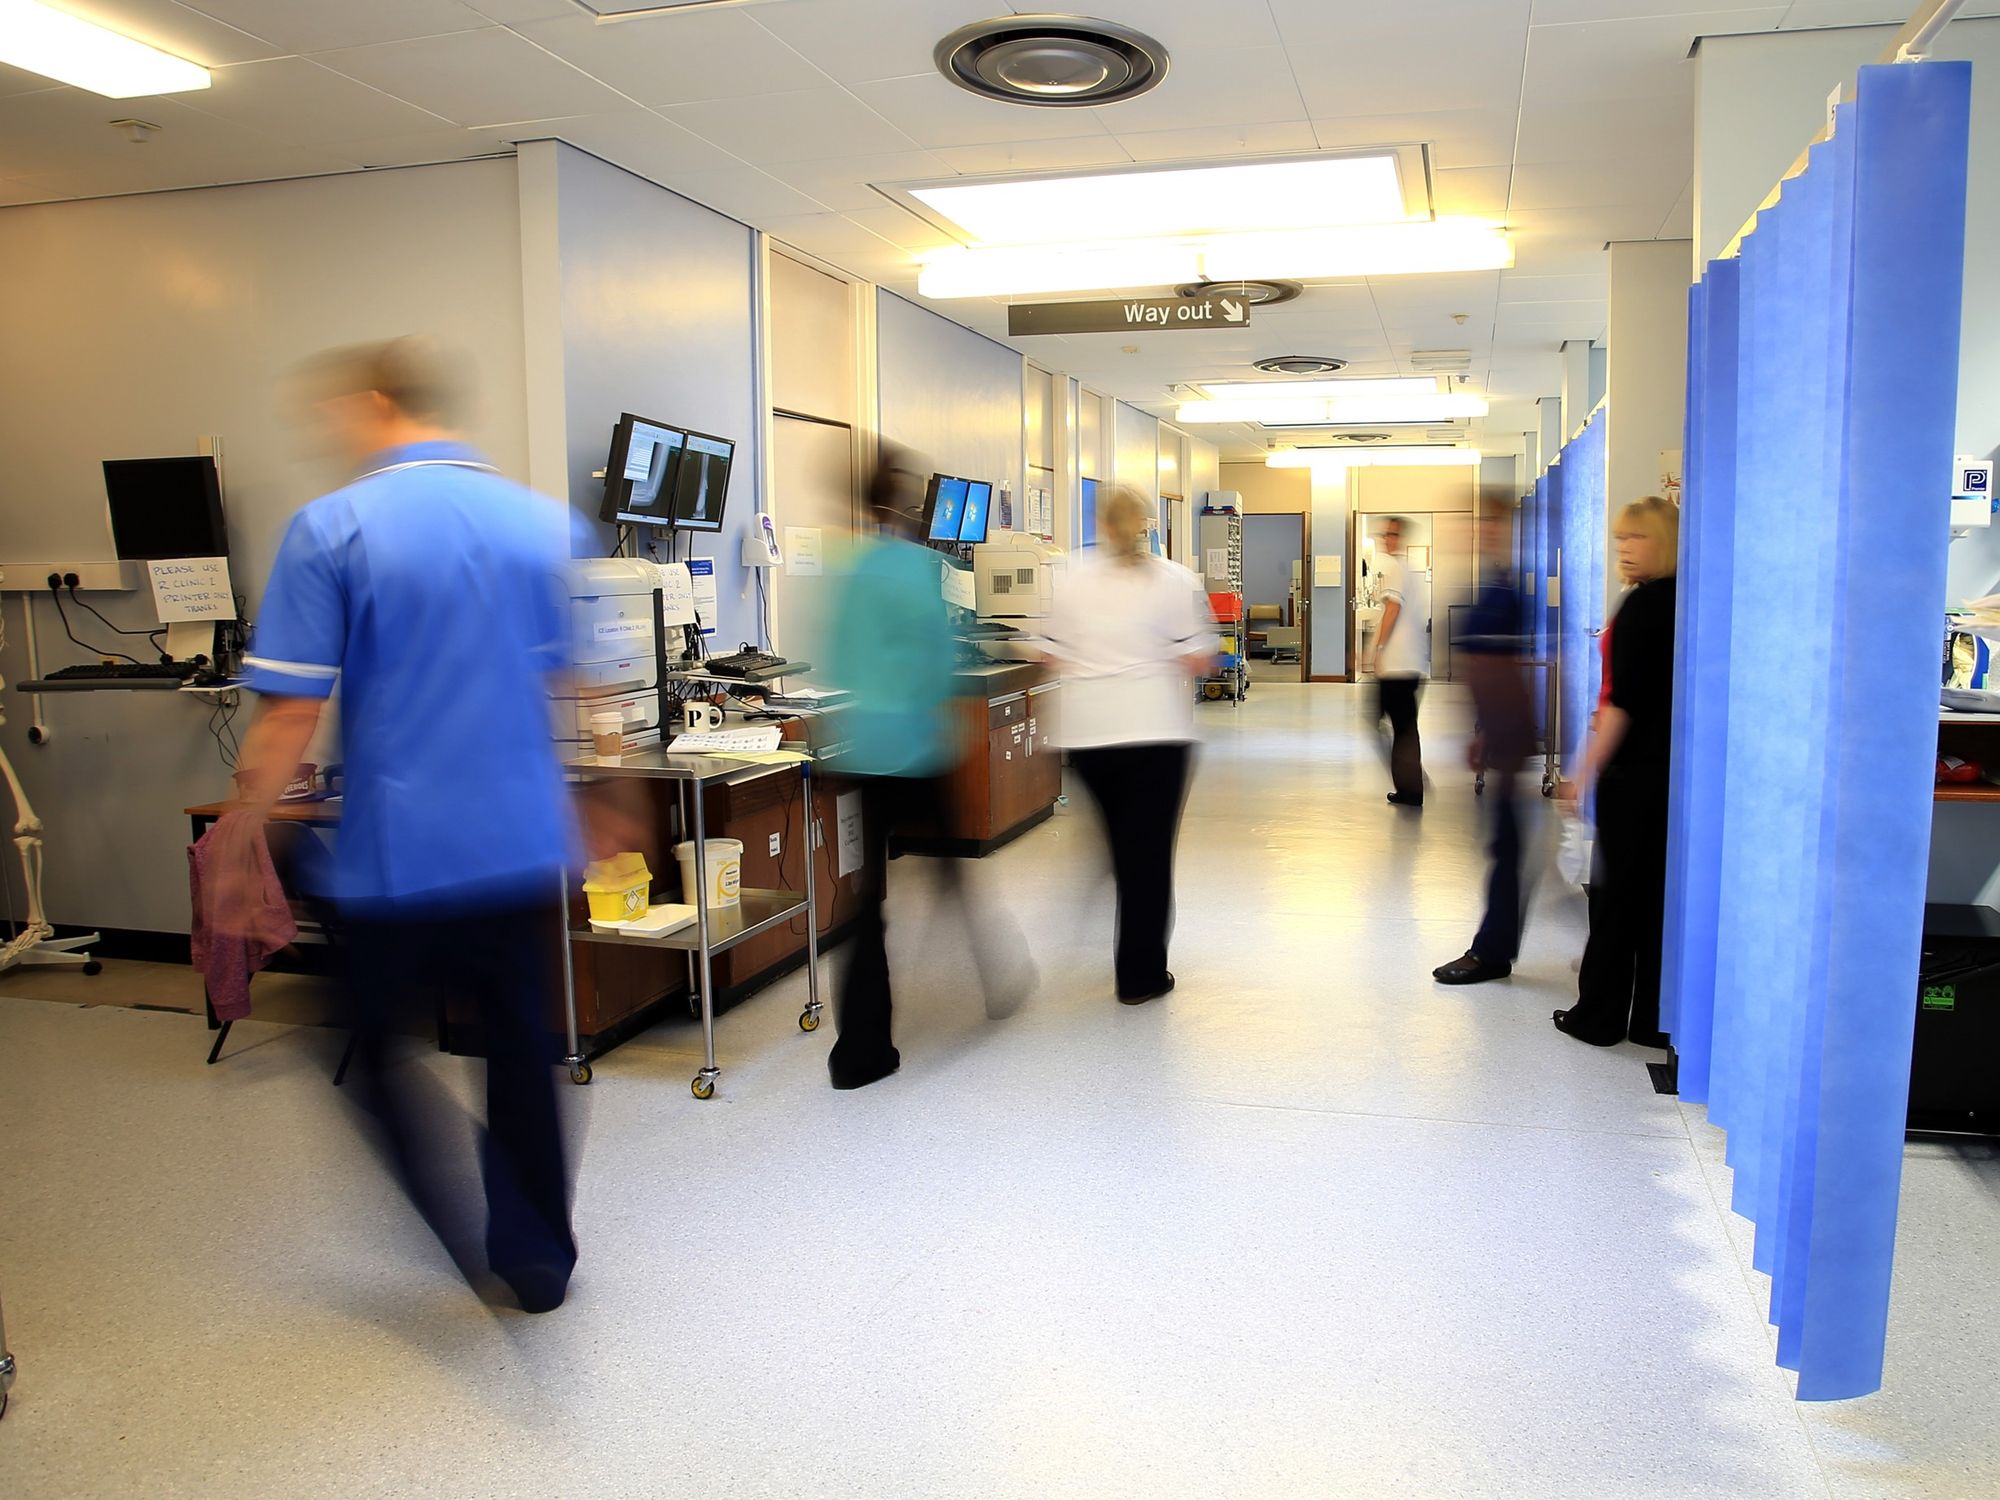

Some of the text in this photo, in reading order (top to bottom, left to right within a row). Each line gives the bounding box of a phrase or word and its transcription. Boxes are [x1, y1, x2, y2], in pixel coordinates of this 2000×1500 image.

[1124, 301, 1213, 325] Way out
[153, 564, 219, 575] PLEASE USE
[173, 579, 206, 588] CLINIC
[163, 592, 211, 603] PRINTER
[688, 710, 702, 727] P
